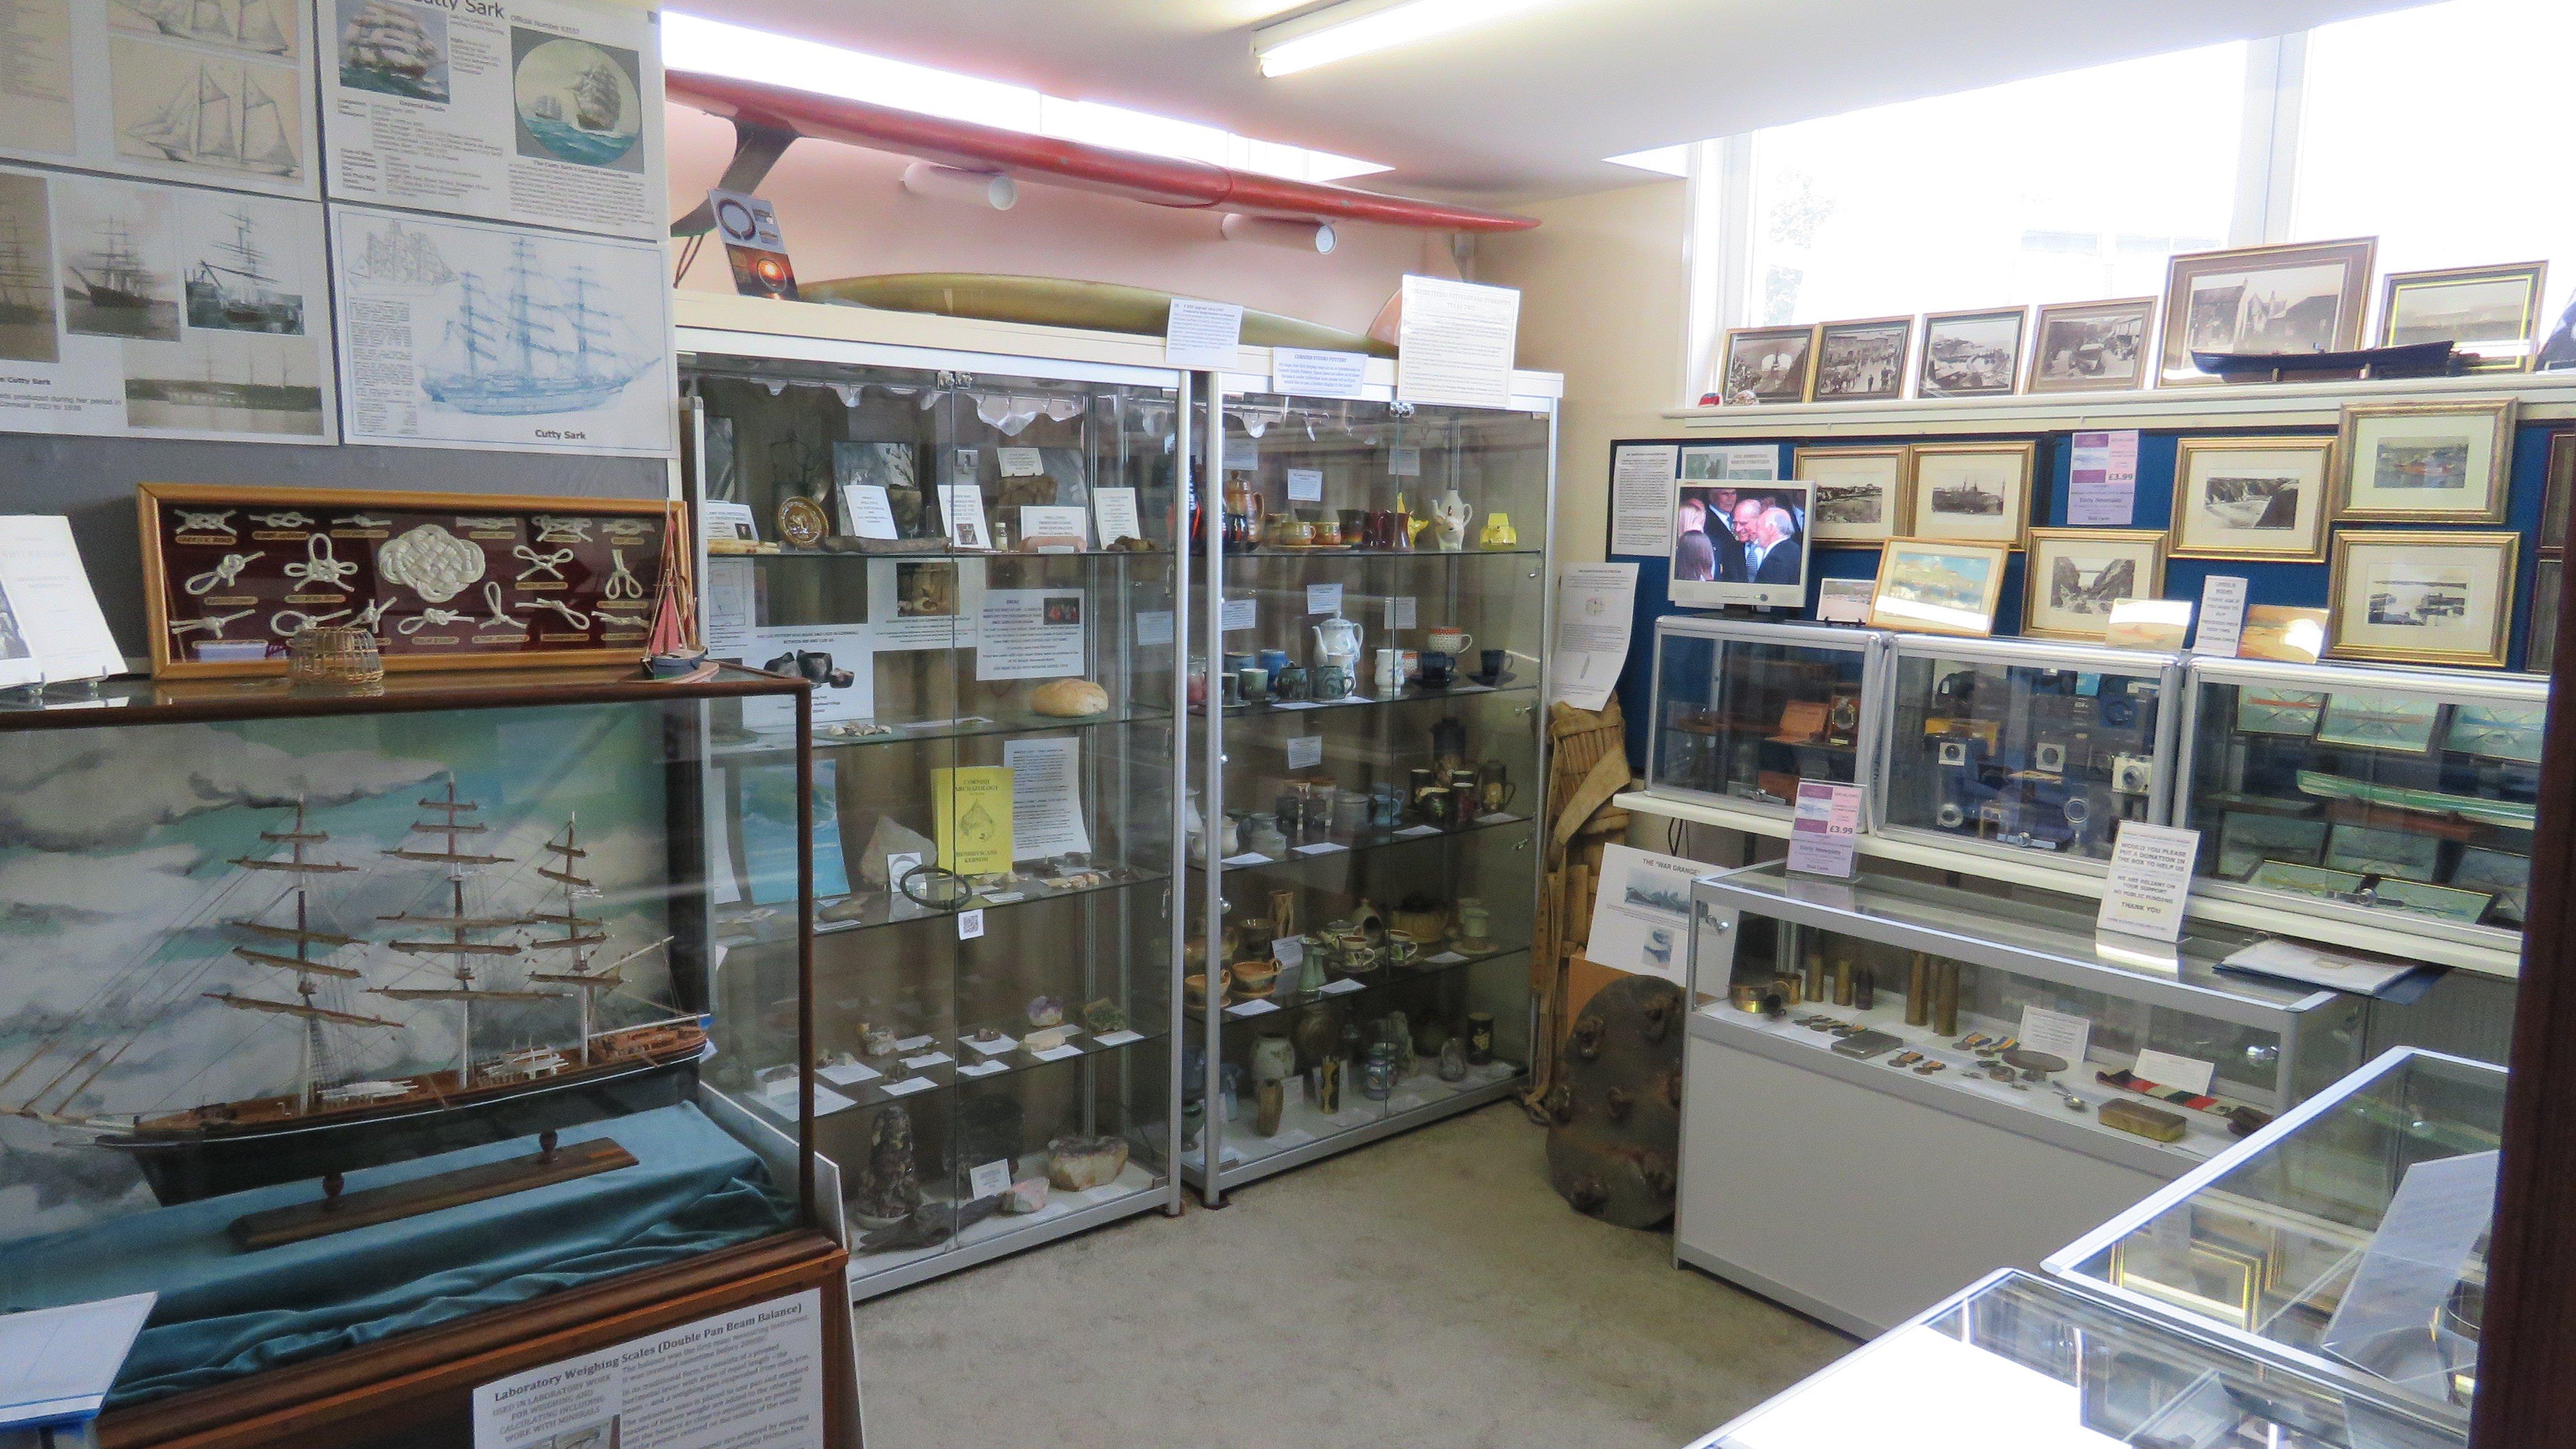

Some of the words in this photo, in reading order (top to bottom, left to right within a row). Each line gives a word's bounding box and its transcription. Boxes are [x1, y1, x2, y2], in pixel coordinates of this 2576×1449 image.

[465, 0, 505, 20] Sark
[535, 429, 561, 440] Cutty
[564, 431, 586, 440] Sark
[1829, 825, 1853, 835] £3.99
[2121, 842, 2144, 850] WOULD
[2162, 848, 2186, 857] PLEASE
[2139, 852, 2175, 863] DONATION
[1656, 861, 1671, 870] "WAR
[2121, 901, 2144, 911] THANK
[495, 1374, 562, 1402] Laboratory
[565, 1357, 620, 1380] Weighing
[622, 1346, 656, 1363] Scales
[657, 1332, 701, 1353] (Double
[704, 1325, 723, 1339] Pan
[726, 1318, 756, 1333] Beam
[757, 1303, 803, 1323] Balance)
[528, 1383, 583, 1405] LABORATORY
[585, 1375, 610, 1387] WORK
[512, 1410, 527, 1420] FOR
[531, 1395, 573, 1414] WEIGHING
[575, 1389, 593, 1400] AND
[499, 1410, 556, 1434] CALCULATING
[505, 1429, 531, 1442] WORK
[533, 1421, 556, 1433] WITH
[558, 1407, 600, 1425] MINERALS
